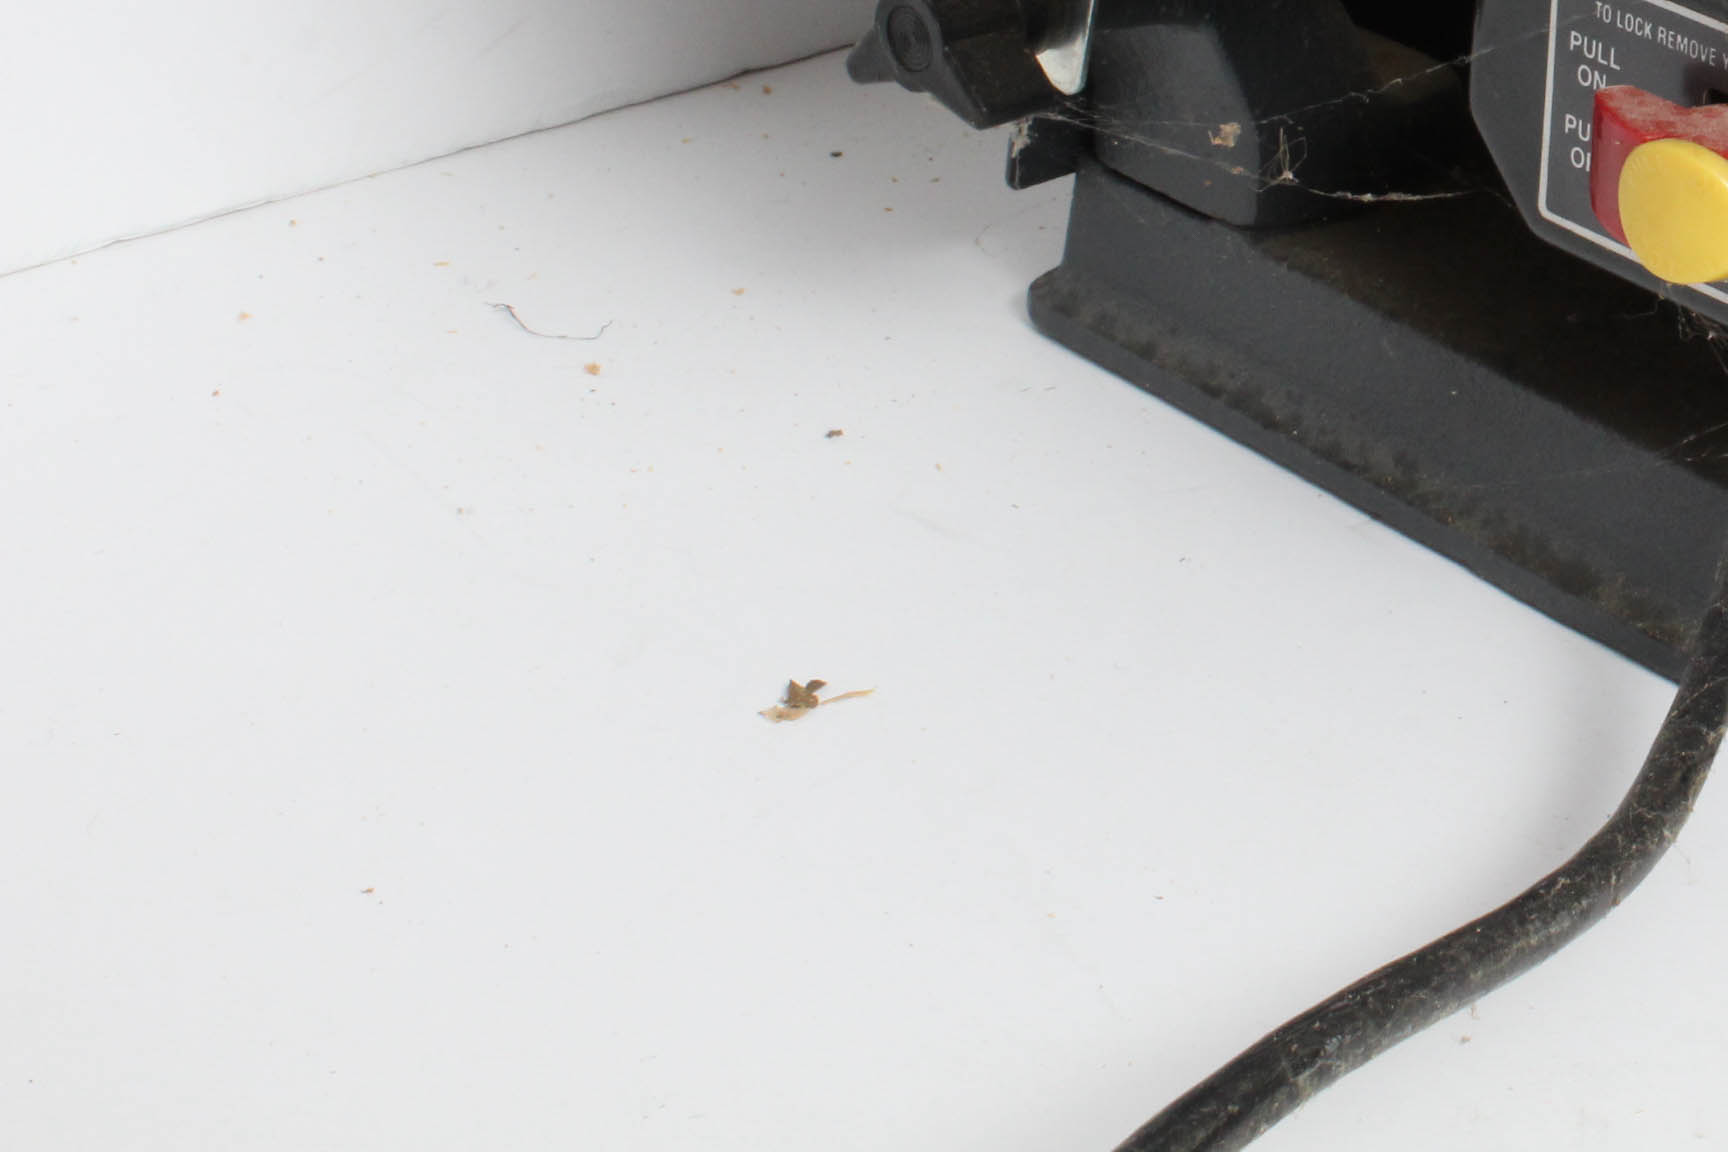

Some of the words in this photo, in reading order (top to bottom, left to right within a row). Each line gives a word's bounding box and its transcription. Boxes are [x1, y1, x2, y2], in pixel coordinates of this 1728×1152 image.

[1570, 30, 1621, 71] PULL
[1595, 1, 1612, 24] TO
[1617, 10, 1653, 40] LOCK
[1657, 26, 1717, 66] REMOVE
[1577, 65, 1608, 91] ON
[1565, 113, 1592, 142] PU
